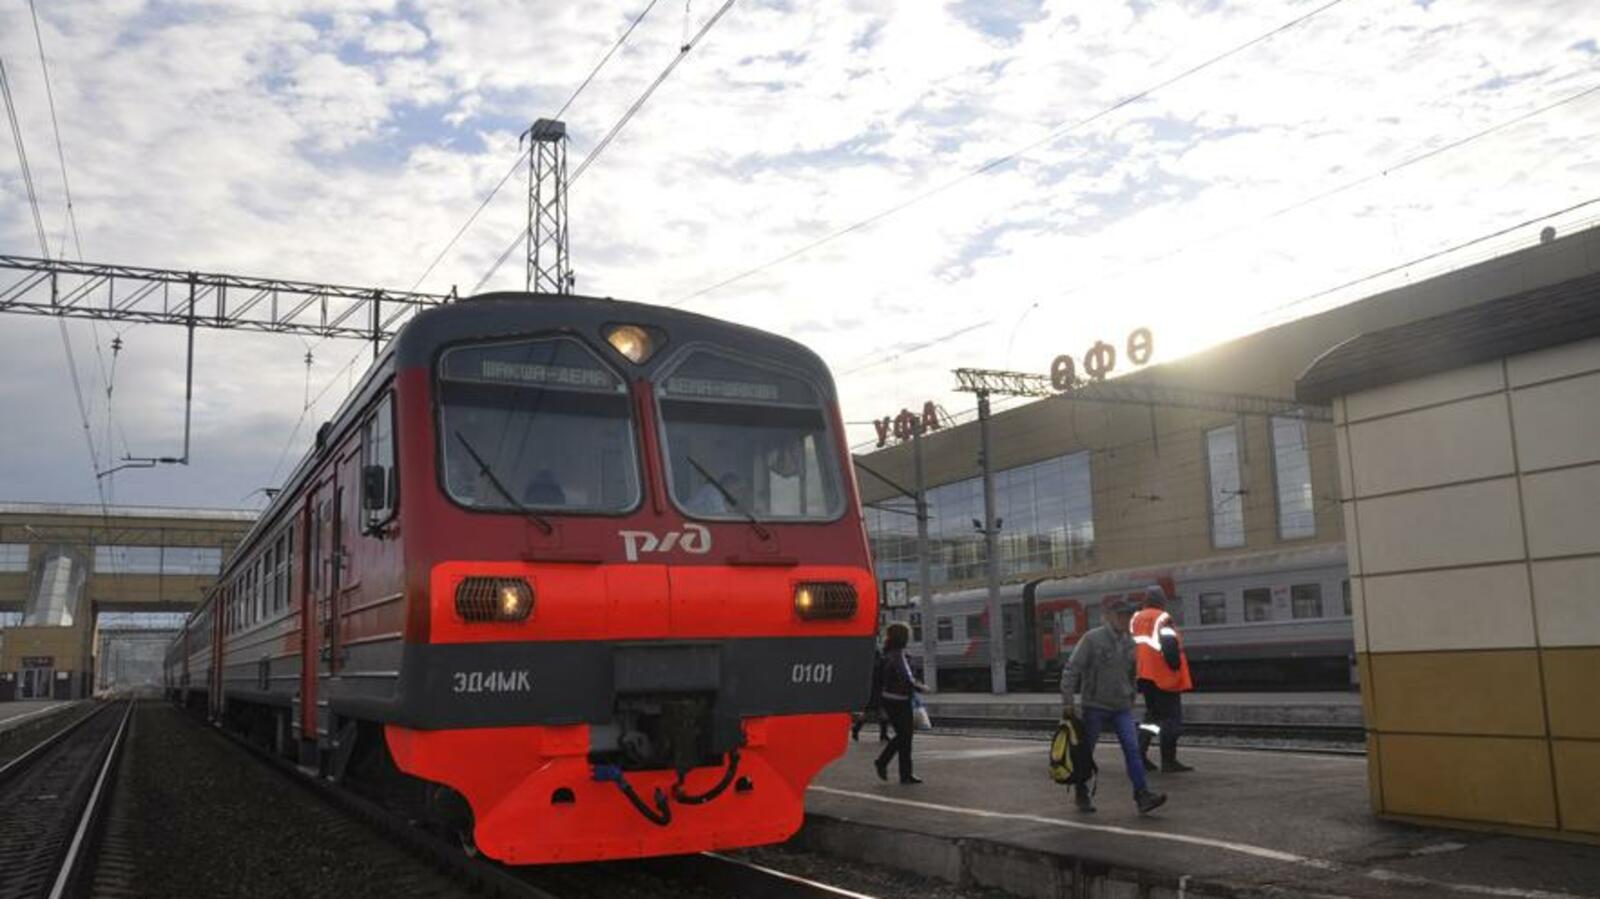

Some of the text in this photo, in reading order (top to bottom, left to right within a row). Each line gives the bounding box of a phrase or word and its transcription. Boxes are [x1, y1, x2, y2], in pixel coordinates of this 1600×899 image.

[874, 401, 939, 448] УФА
[453, 671, 531, 692] ЭД4МК
[792, 664, 833, 684] 0101
